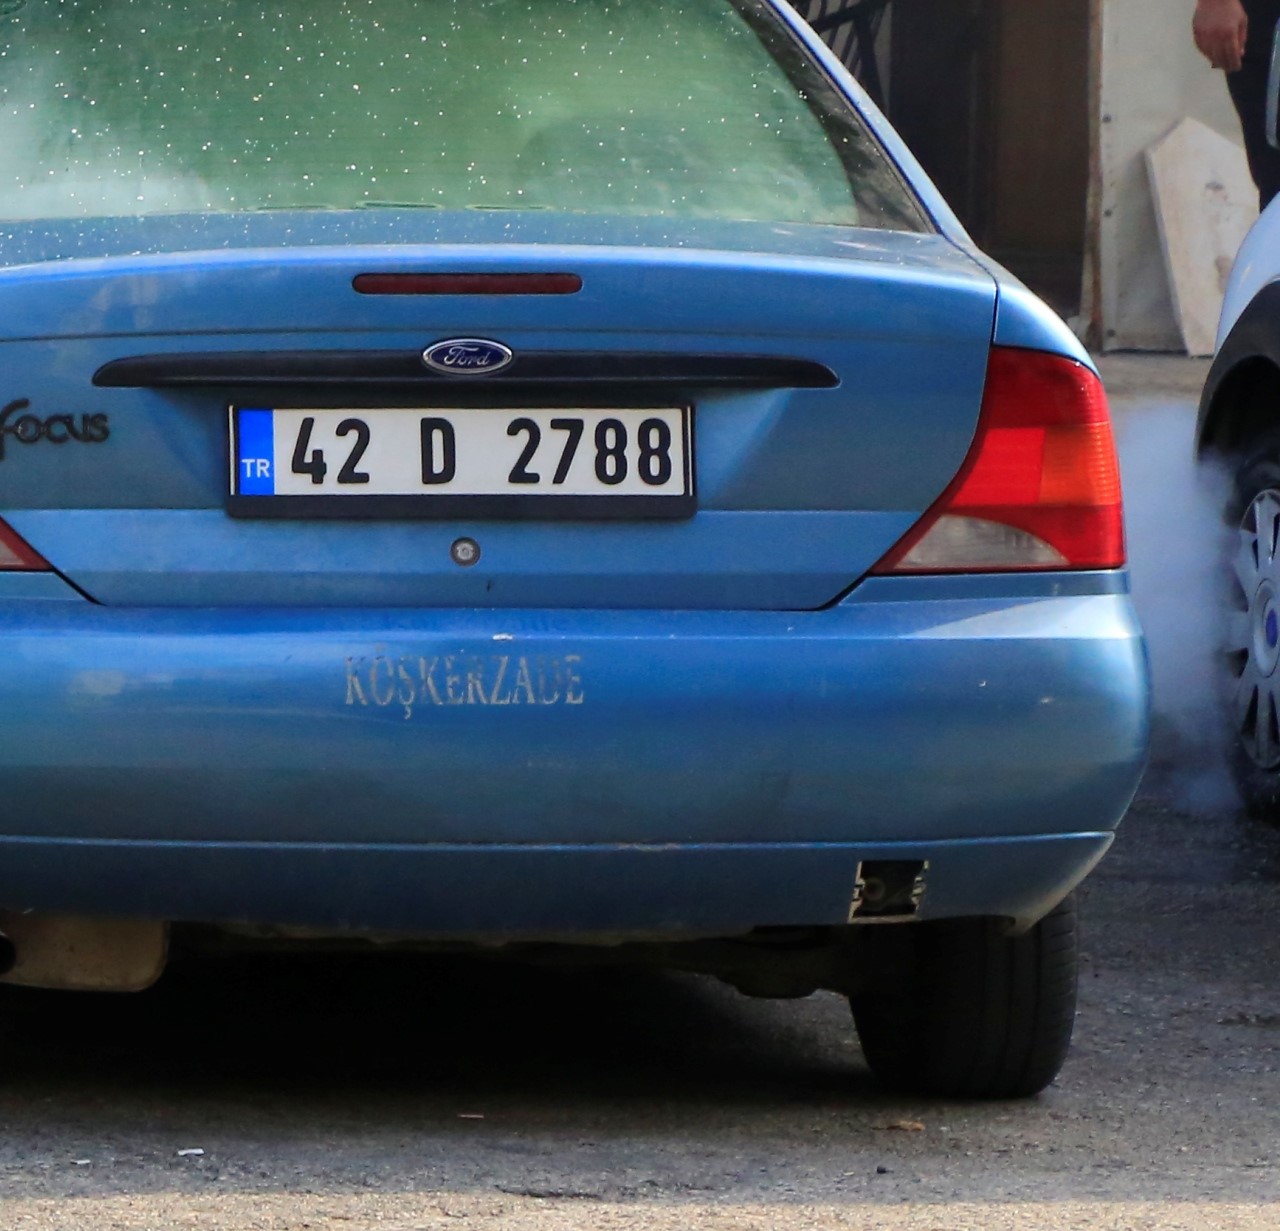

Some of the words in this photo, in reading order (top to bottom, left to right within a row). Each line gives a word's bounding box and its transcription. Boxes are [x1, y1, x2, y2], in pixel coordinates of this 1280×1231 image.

[443, 345, 491, 366] Ford
[242, 458, 271, 478] TR
[291, 416, 371, 485] 42
[420, 417, 456, 484] D
[506, 417, 672, 485] 2788
